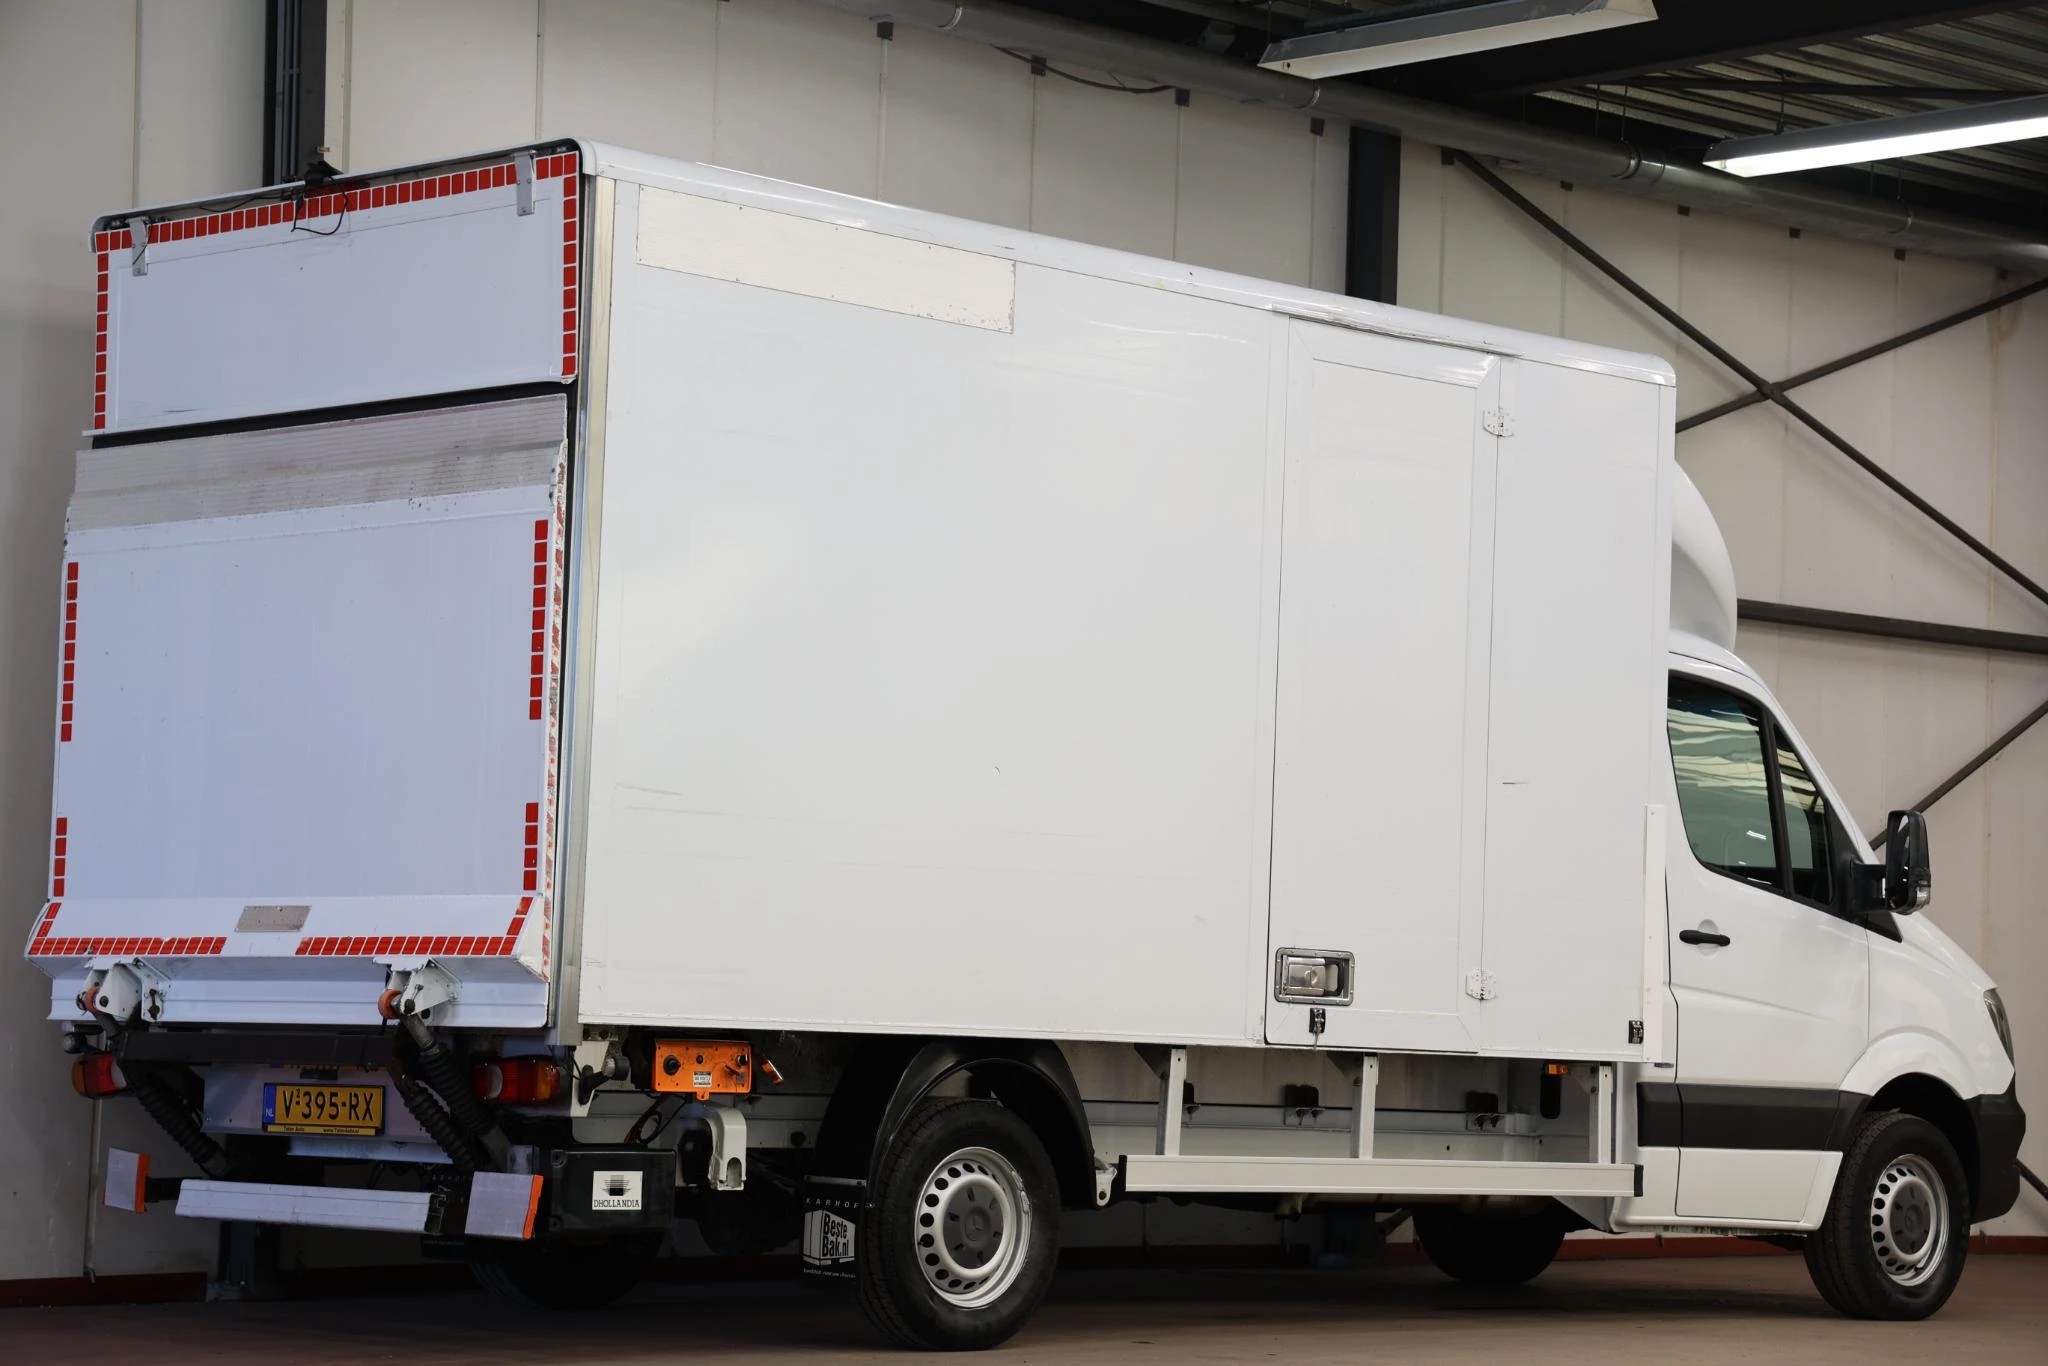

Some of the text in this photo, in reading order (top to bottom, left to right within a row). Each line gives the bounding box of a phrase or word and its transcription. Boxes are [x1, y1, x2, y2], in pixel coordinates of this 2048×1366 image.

[265, 1108, 274, 1118] NL
[593, 1199, 640, 1208] DHOLLANDIA
[823, 1212, 848, 1240] Beste
[822, 1235, 849, 1257] Bak.nl
